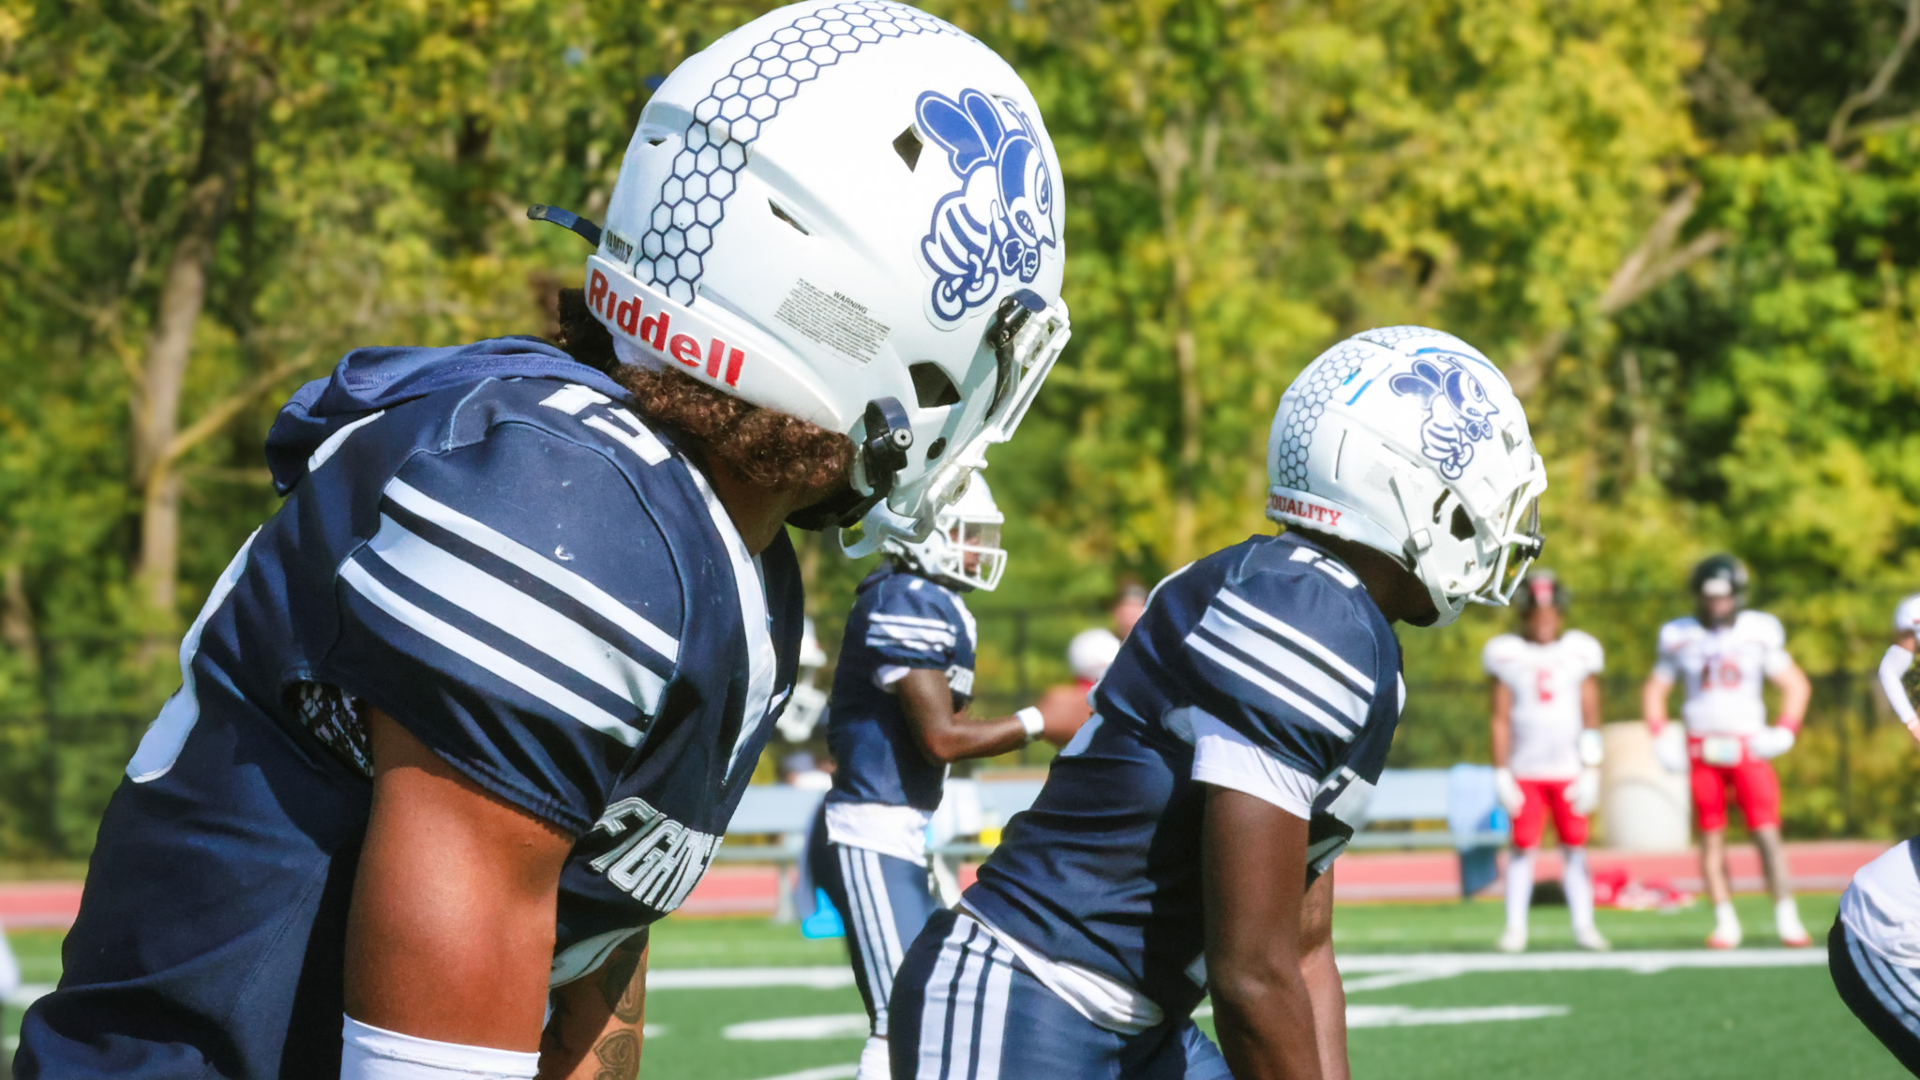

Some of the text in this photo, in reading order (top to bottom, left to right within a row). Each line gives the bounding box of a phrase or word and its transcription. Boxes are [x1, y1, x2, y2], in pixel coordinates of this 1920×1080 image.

[833, 291, 867, 314] WARNING
[589, 268, 745, 387] Riddell
[1267, 493, 1342, 526] QUALITY
